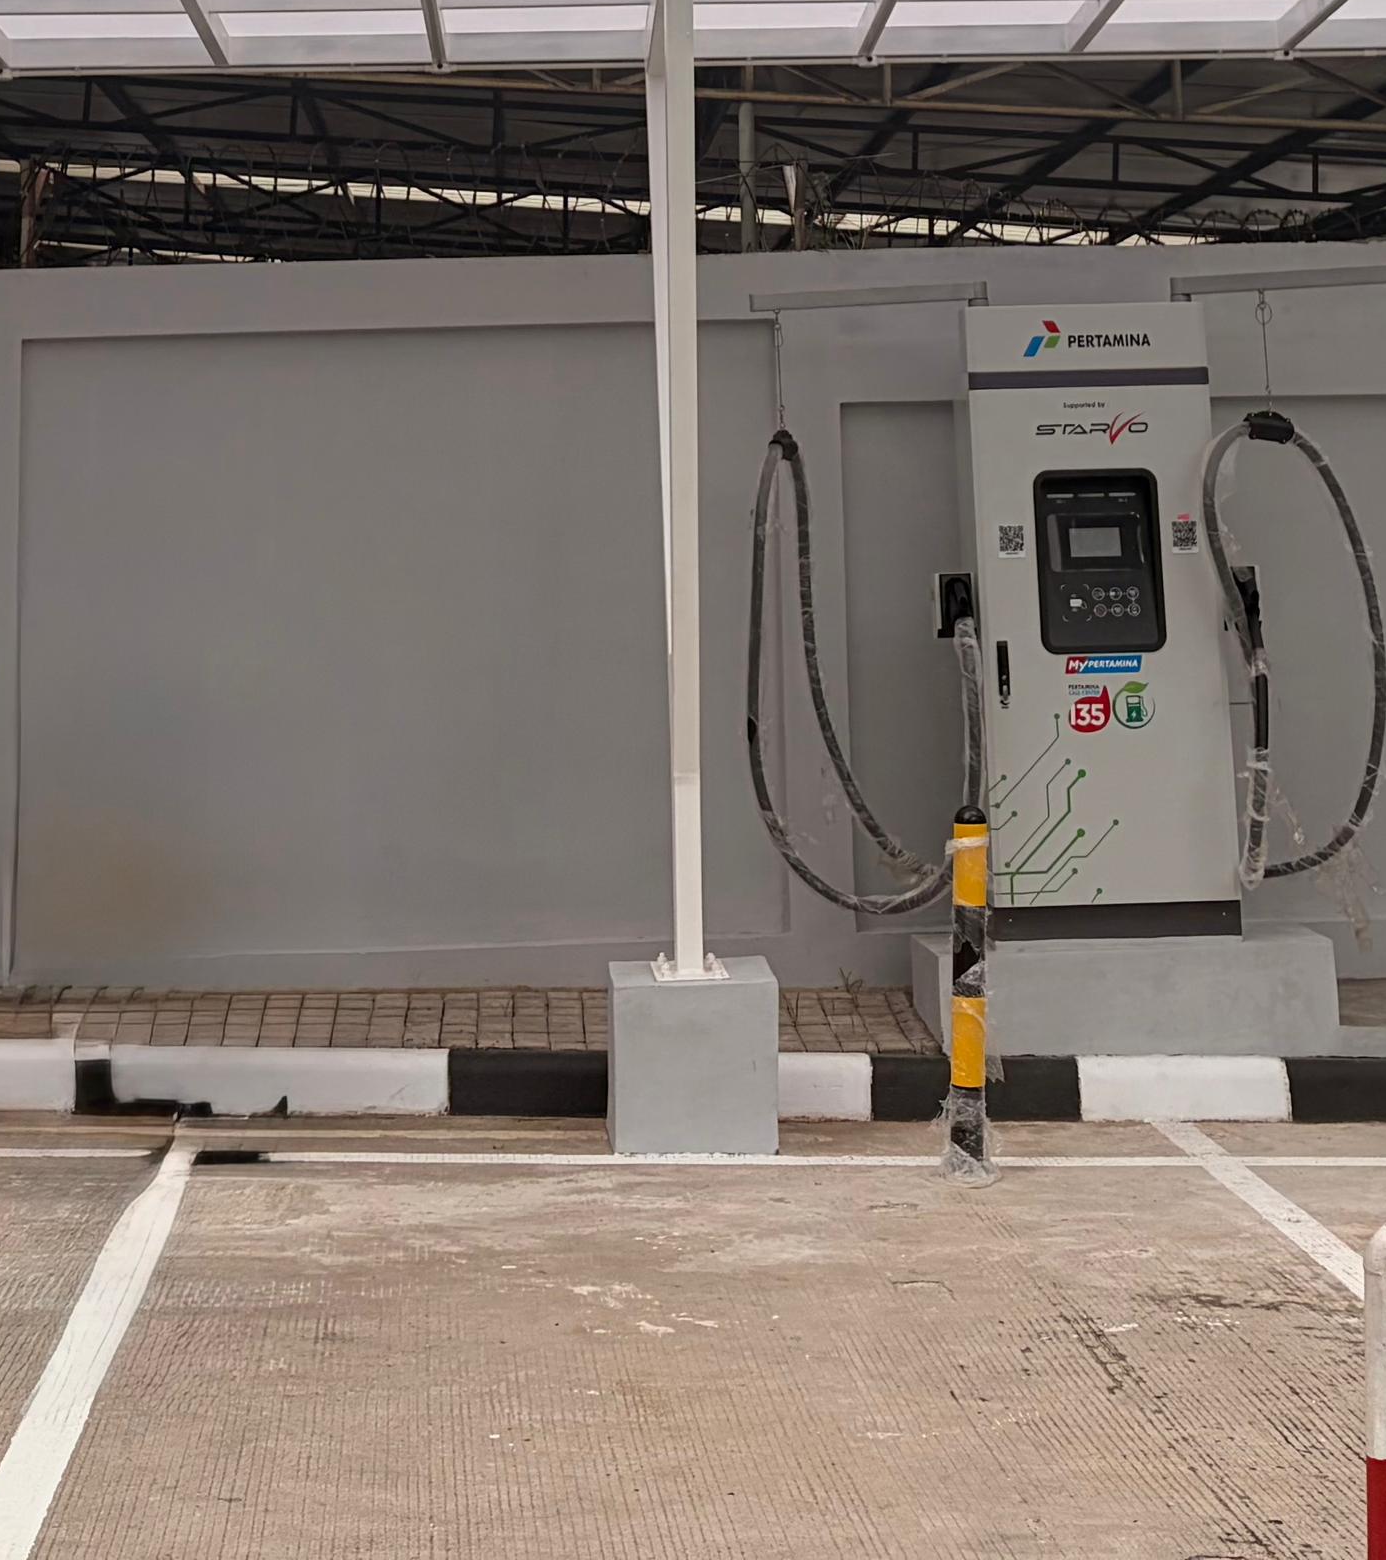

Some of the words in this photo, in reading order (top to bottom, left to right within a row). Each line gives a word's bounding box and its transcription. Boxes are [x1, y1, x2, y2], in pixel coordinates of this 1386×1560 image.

[1067, 333, 1151, 348] PERTAMINA
[1035, 412, 1148, 445] STARVO
[1071, 703, 1106, 727] 135
